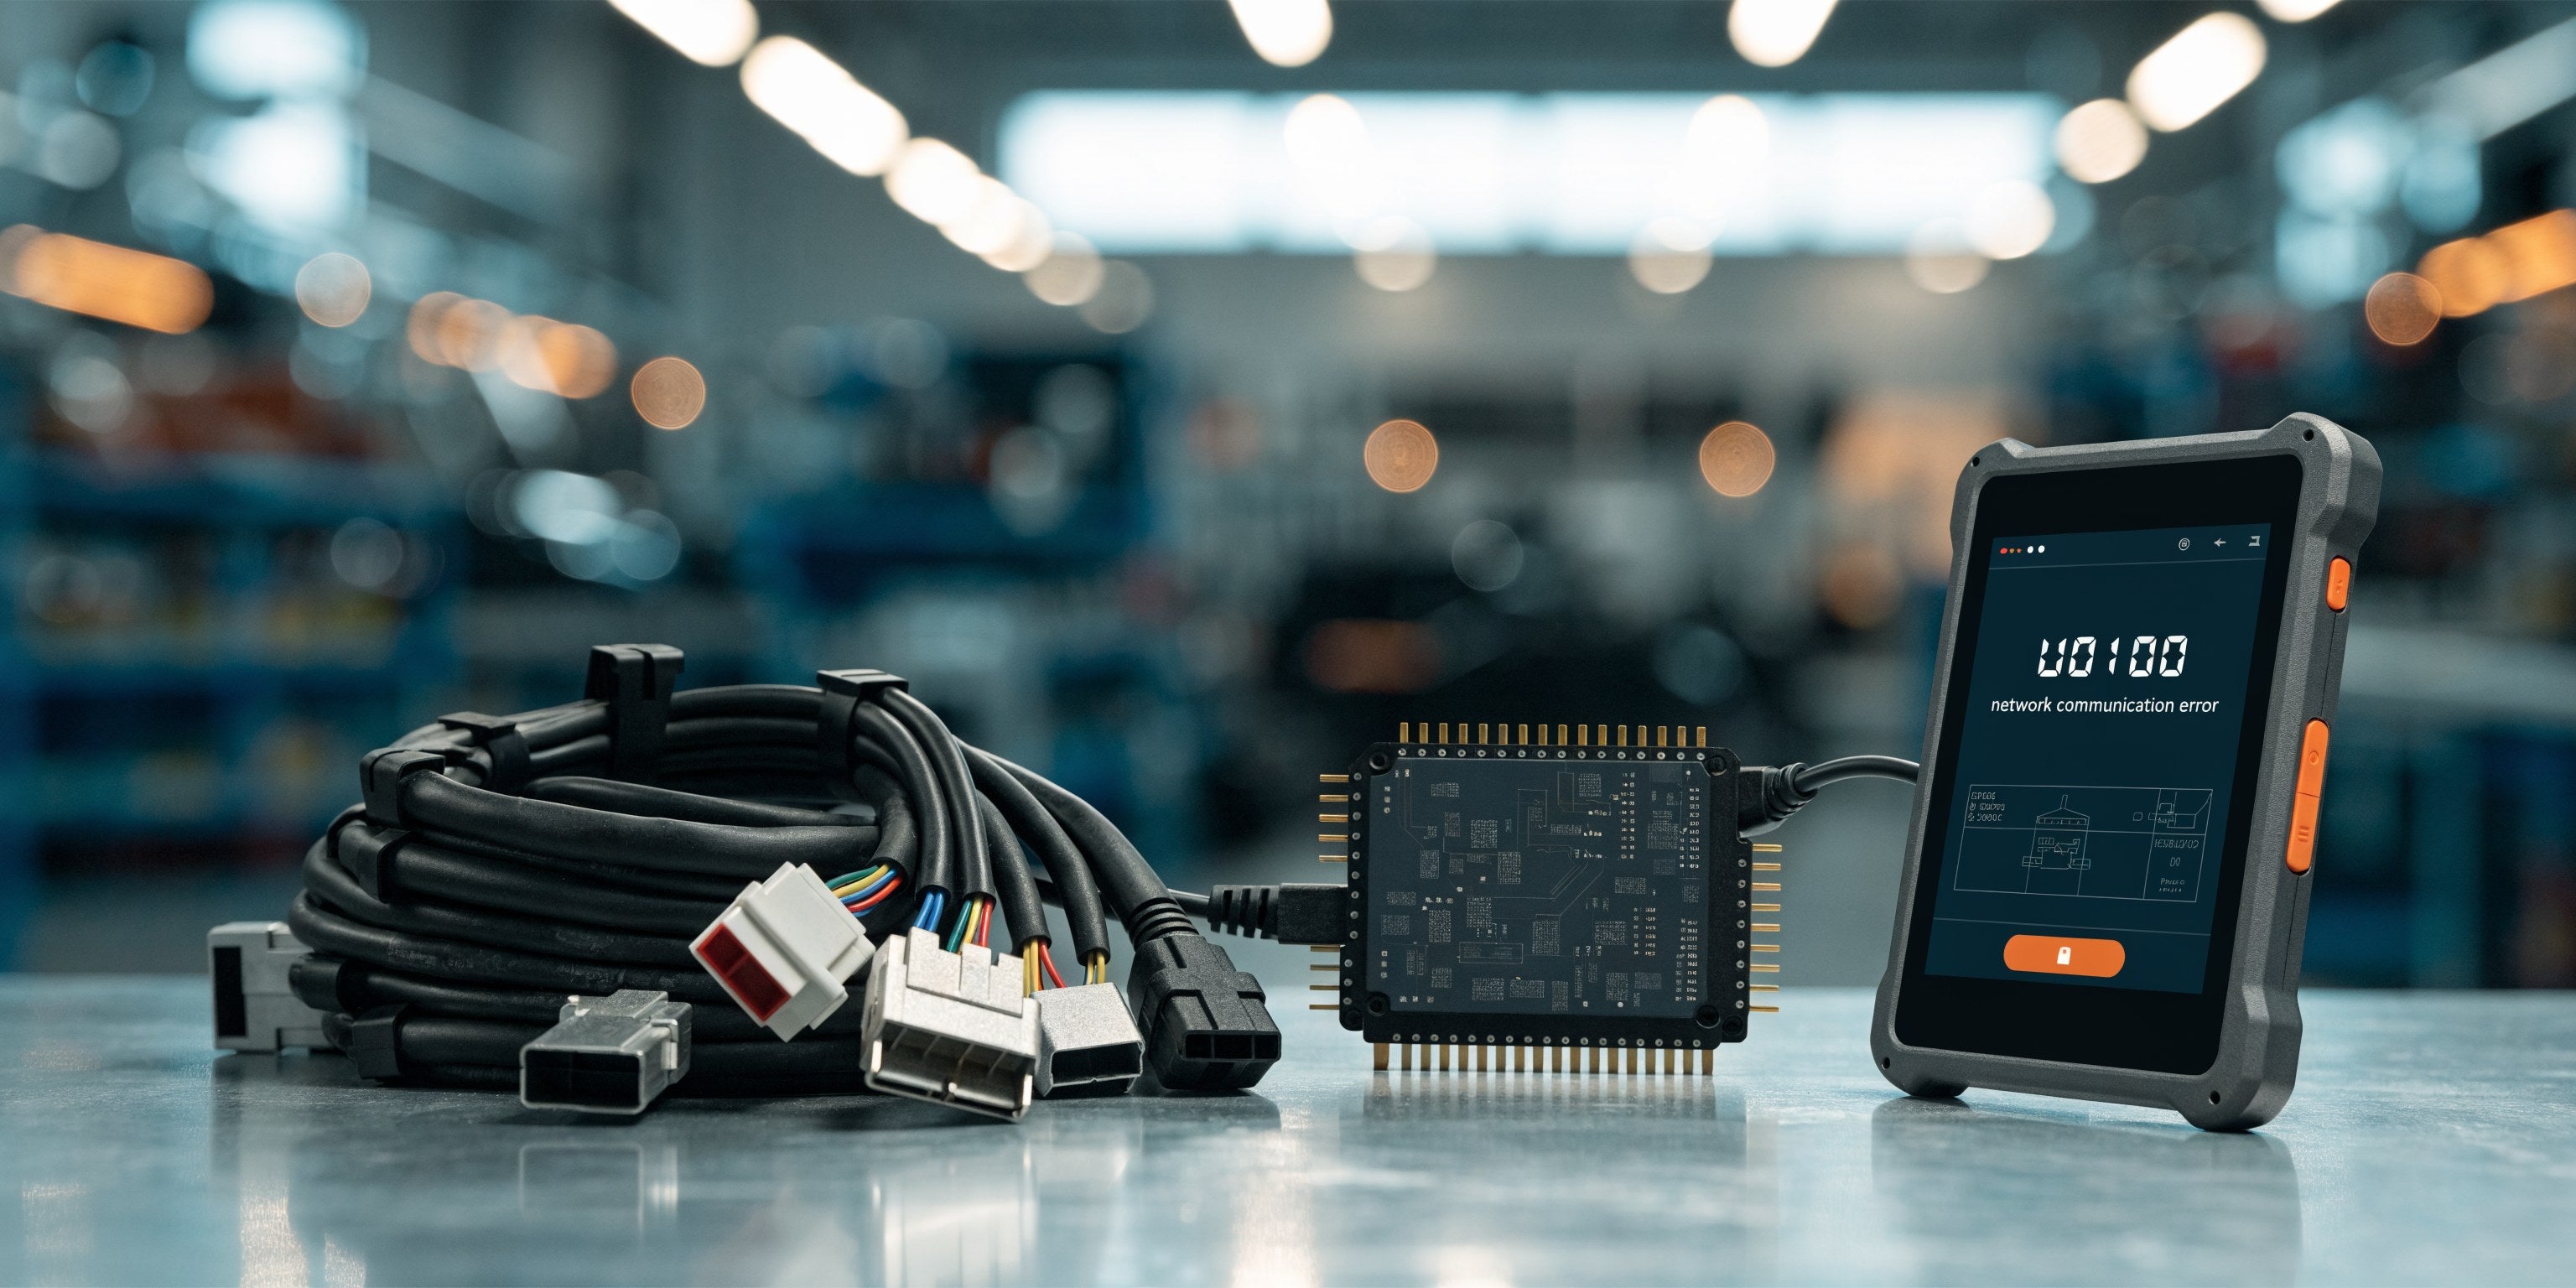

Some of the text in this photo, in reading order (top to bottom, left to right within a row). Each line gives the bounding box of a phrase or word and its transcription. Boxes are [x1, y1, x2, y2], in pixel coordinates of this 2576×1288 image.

[2037, 635, 2189, 678] U0100
[1991, 696, 2220, 713] network communication error
